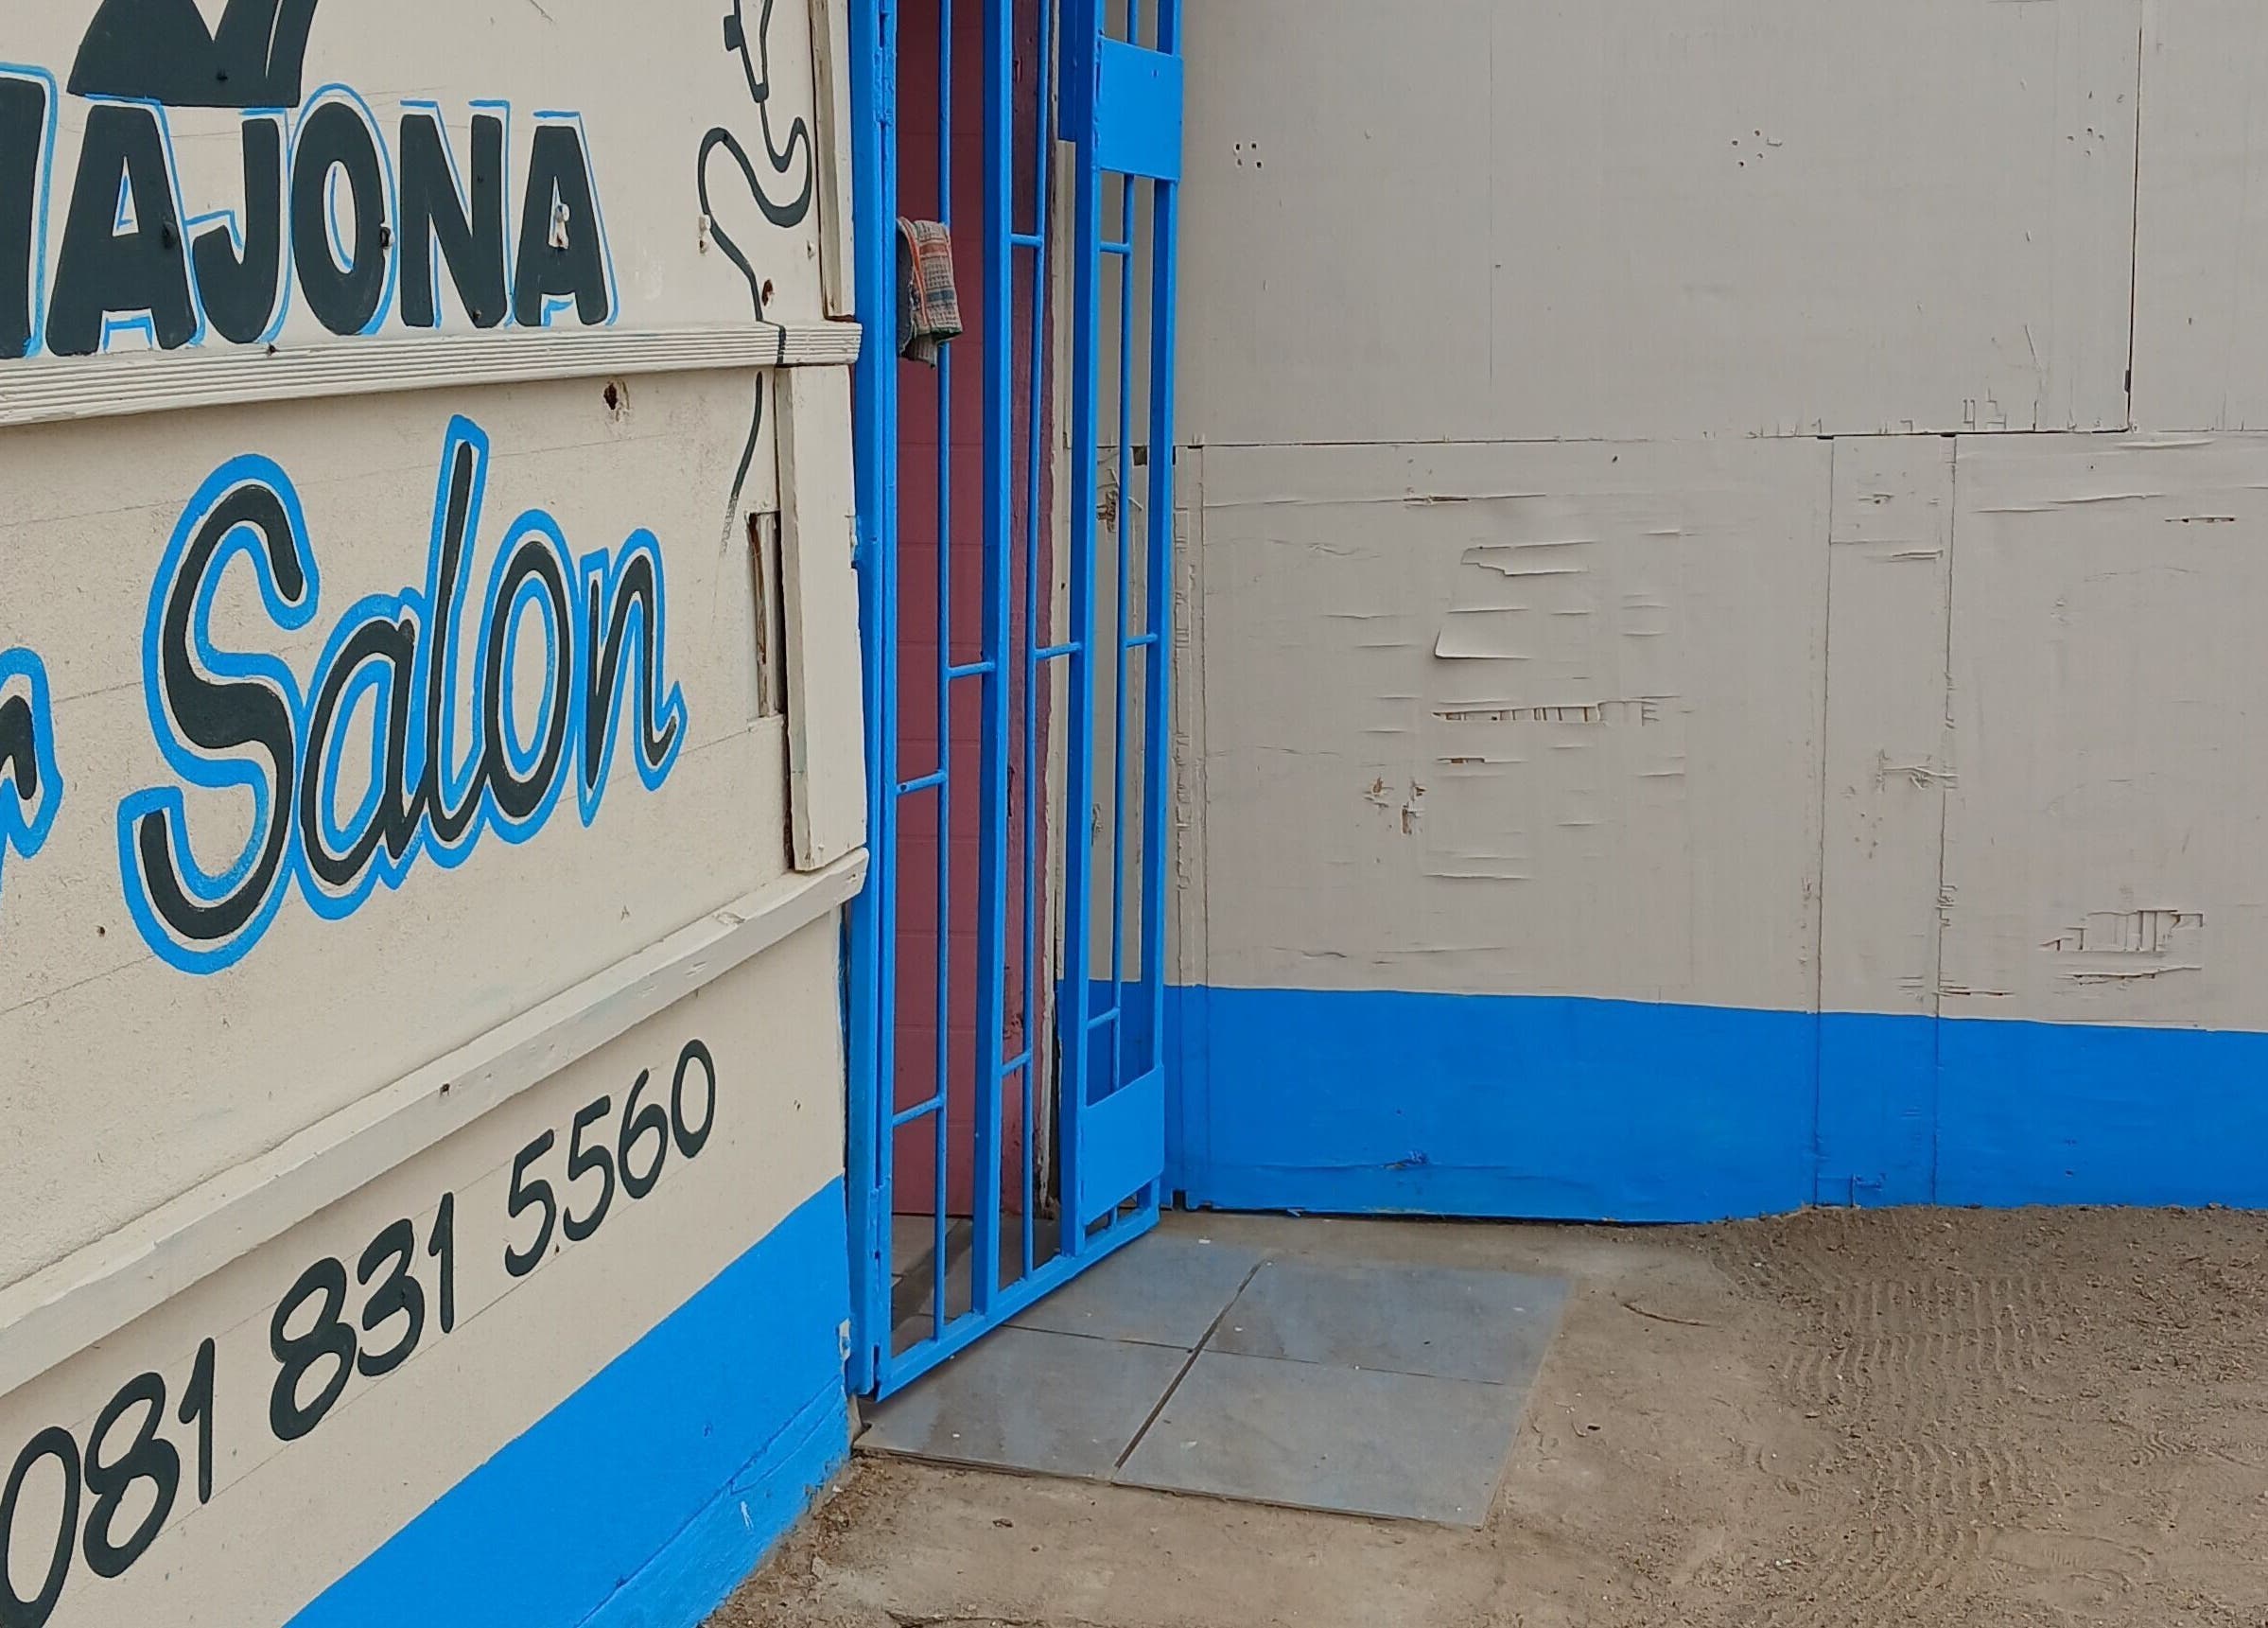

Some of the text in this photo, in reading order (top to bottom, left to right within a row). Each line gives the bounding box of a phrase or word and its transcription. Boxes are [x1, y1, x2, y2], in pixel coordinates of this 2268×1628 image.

[117, 414, 688, 974] Salon
[0, 1039, 715, 1628] 081 831 5560
